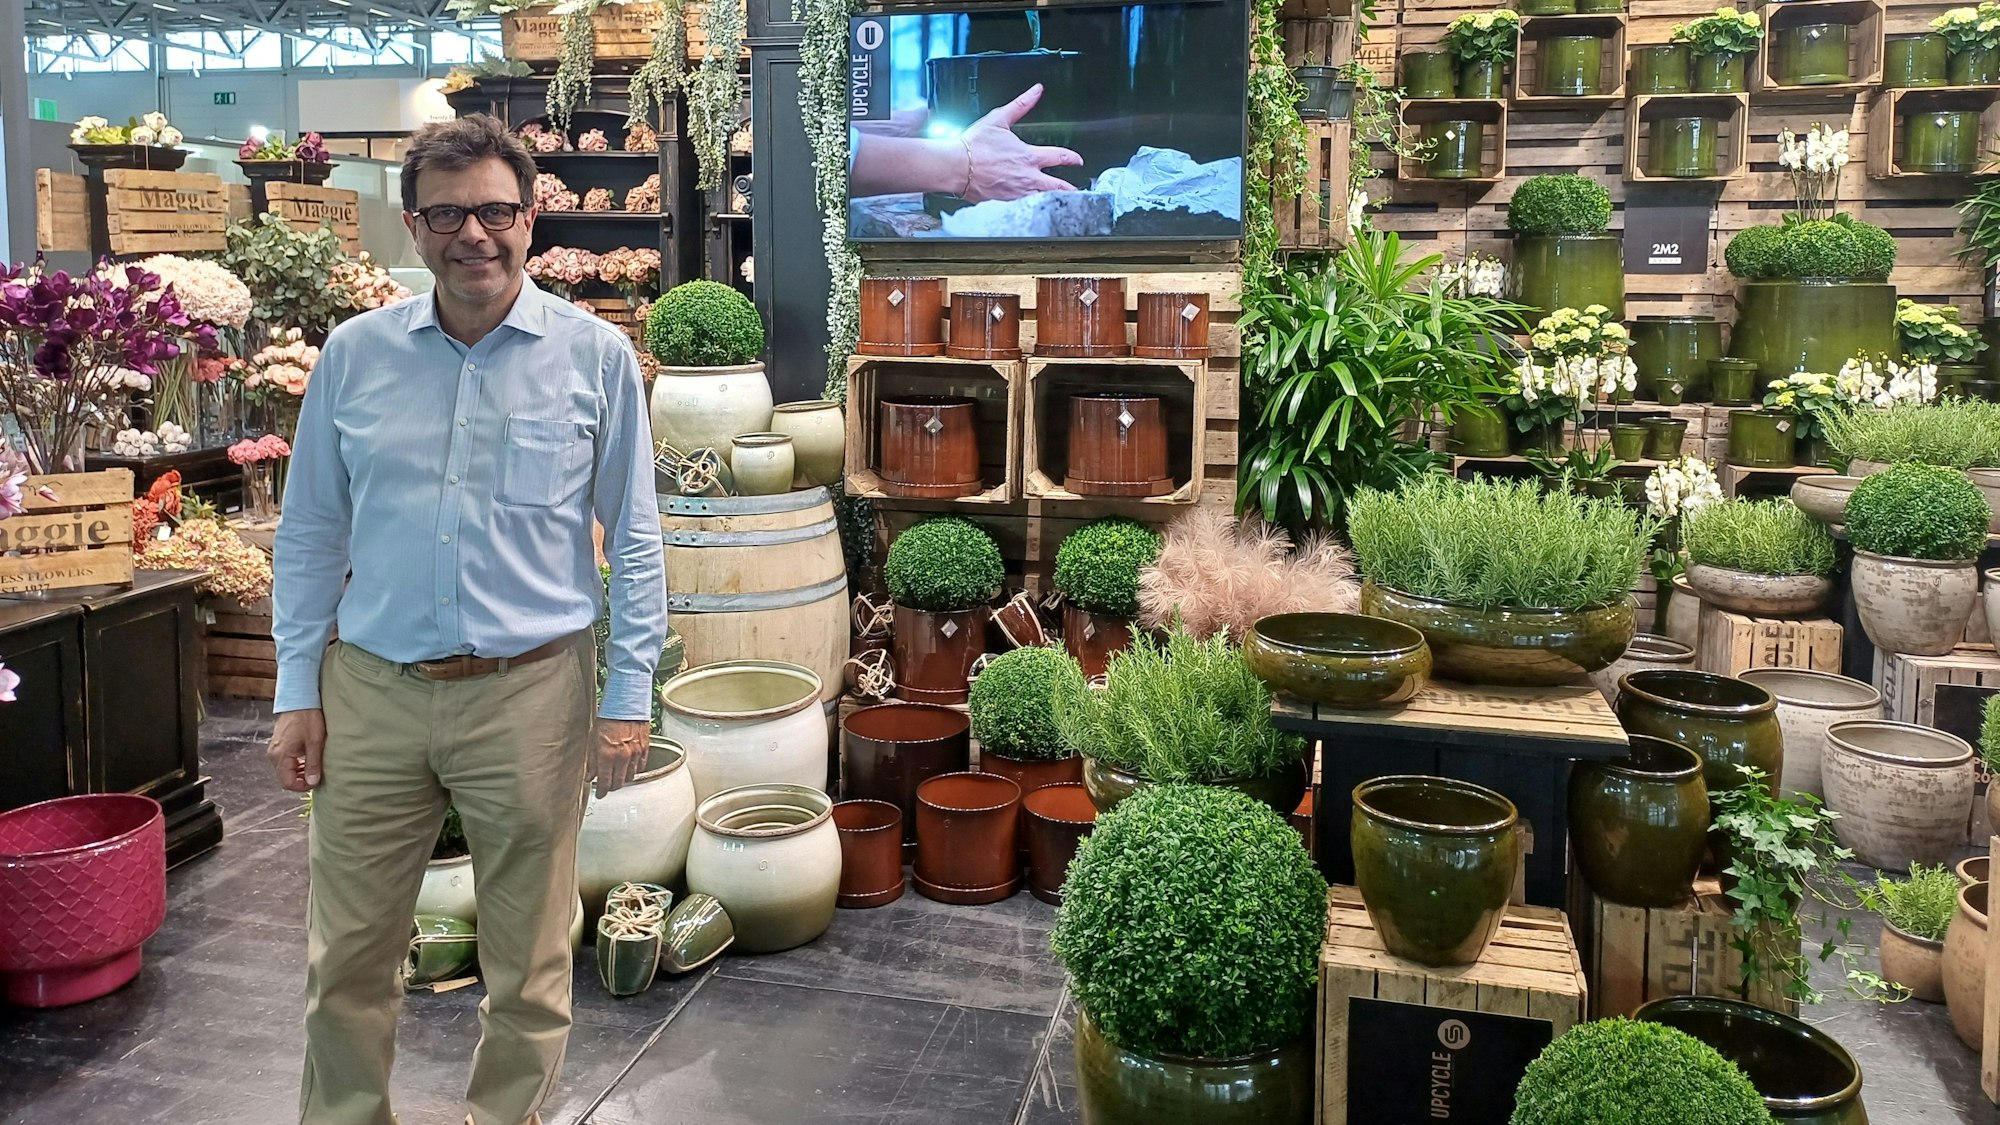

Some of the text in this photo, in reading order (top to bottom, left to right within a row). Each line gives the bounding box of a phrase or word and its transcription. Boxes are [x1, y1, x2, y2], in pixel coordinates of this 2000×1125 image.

[513, 18, 565, 38] Maggi
[852, 53, 869, 116] UPCYCLE
[138, 186, 217, 213] Maggie
[293, 197, 353, 223] Maggie
[1652, 243, 1679, 255] 2M2
[28, 567, 95, 583] FLOWERS
[1430, 1051, 1452, 1119] UPCYCLE
